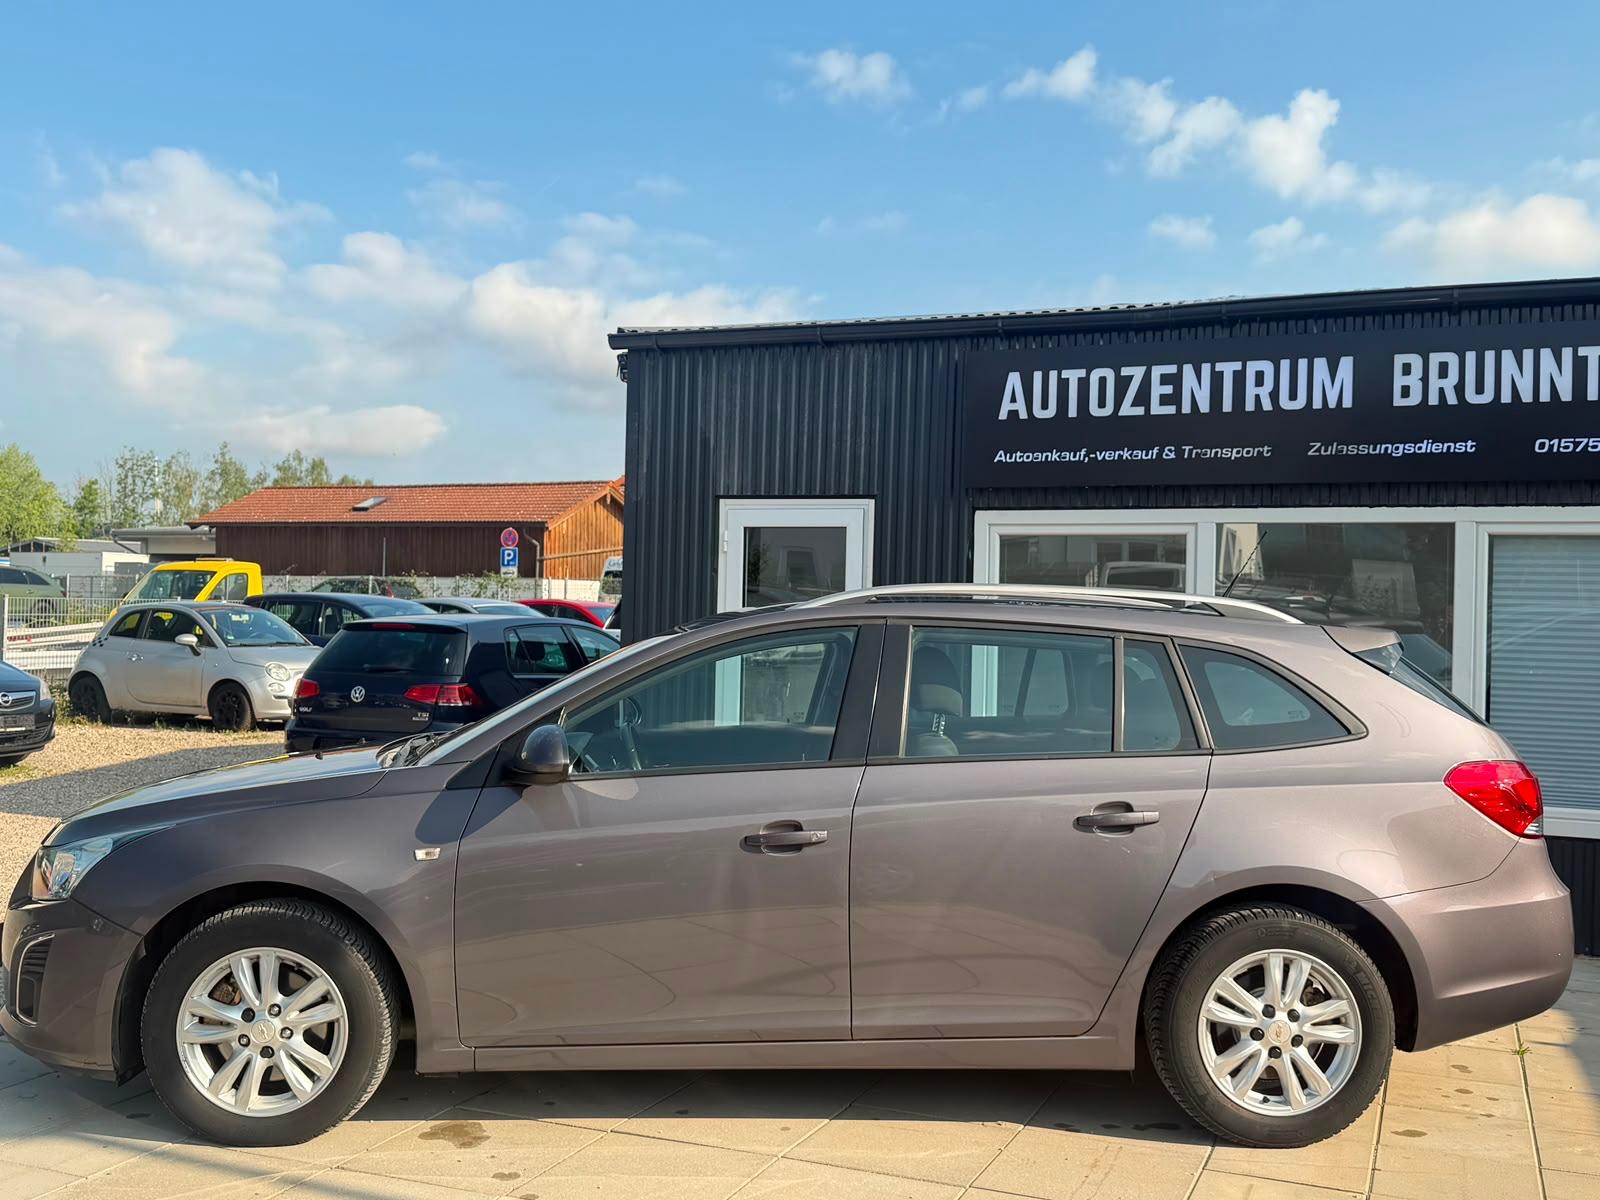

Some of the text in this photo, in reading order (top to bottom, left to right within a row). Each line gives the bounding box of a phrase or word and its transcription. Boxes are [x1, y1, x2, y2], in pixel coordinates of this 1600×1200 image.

[998, 345, 1600, 420] AUTOZENTRUM BRUNNT
[1162, 446, 1177, 460] &
[1182, 445, 1272, 463] Transport
[1307, 439, 1477, 457] Zulassungsdienst
[1534, 438, 1600, 453] 01575
[504, 549, 514, 565] P
